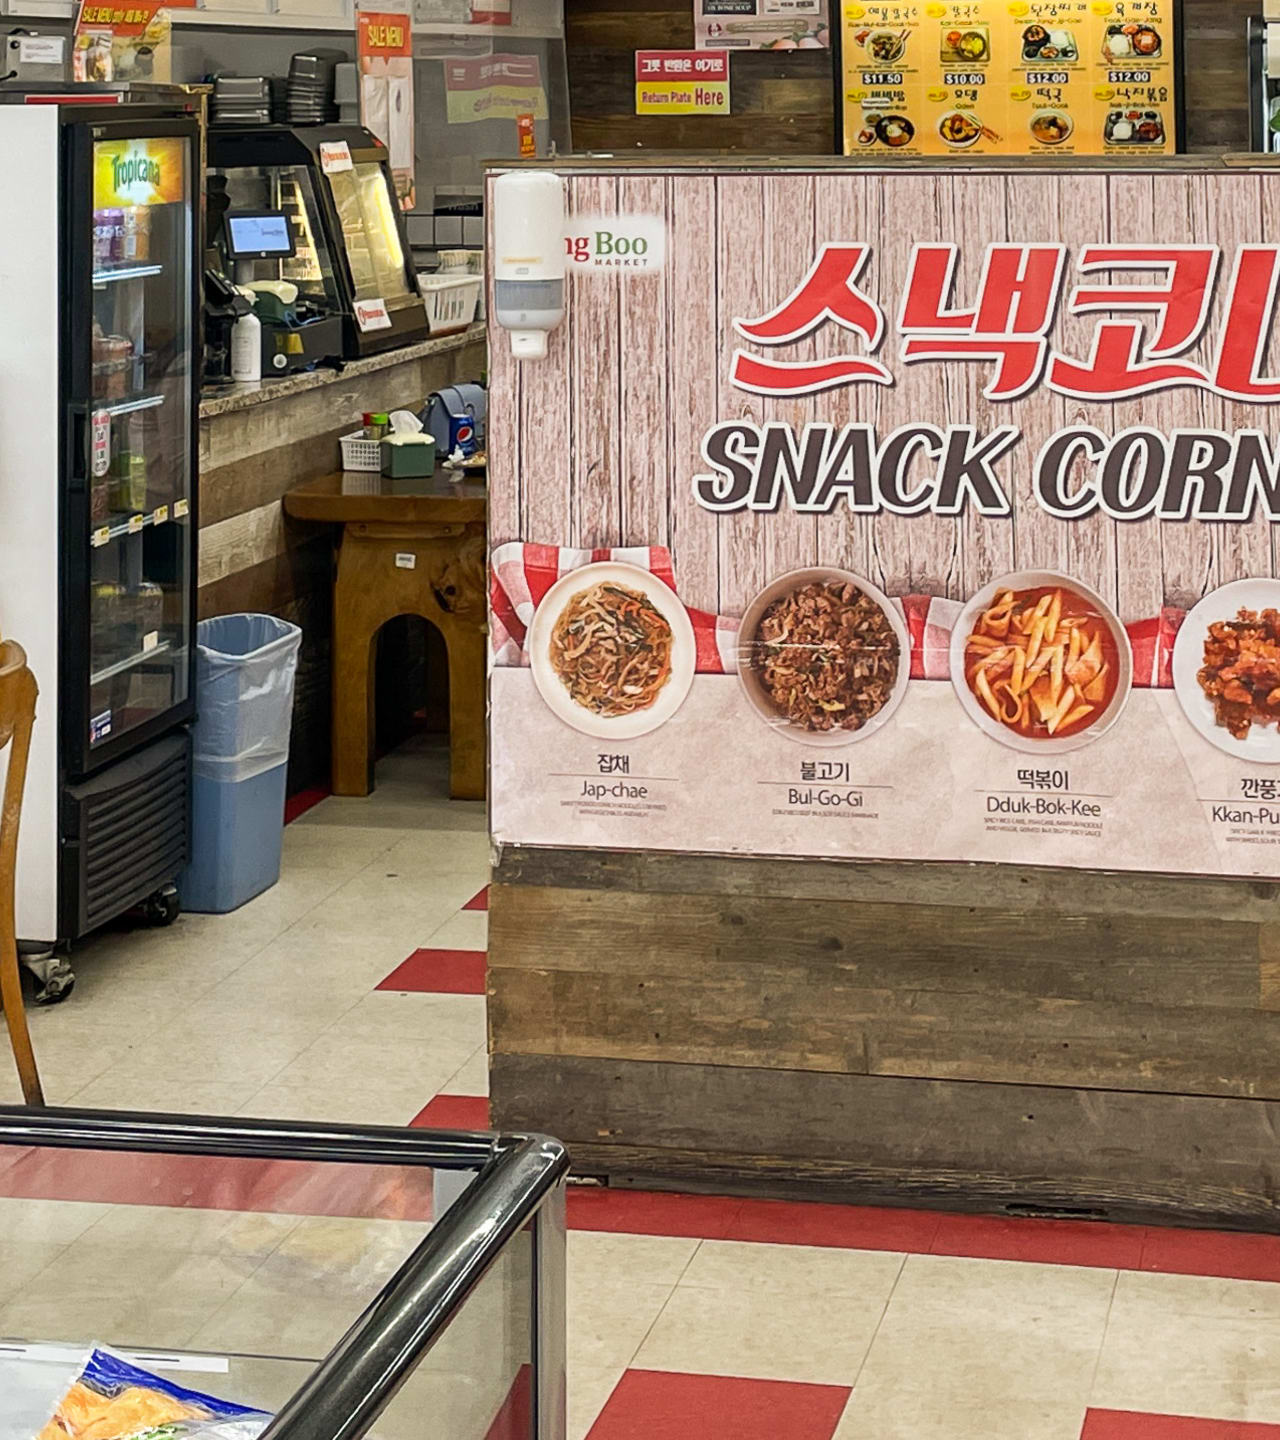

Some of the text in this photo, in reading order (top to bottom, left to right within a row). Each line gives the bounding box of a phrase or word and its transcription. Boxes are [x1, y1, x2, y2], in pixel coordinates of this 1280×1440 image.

[368, 25, 403, 48] SALE MENU
[864, 74, 901, 83] $11.50
[946, 74, 984, 84] $10.00
[1029, 74, 1067, 83] $12.00
[1111, 73, 1149, 82] $12.00
[642, 87, 724, 106] Return Plate Here
[111, 150, 160, 192] Tropicana
[595, 231, 648, 255] Boo
[692, 420, 1023, 516] SNACK
[597, 753, 630, 773] 잡채
[800, 762, 850, 782] 불고기
[1017, 769, 1069, 791] 떡볶이
[581, 781, 648, 800] Jap-chae
[789, 788, 863, 807] Bul-Go-Gi
[987, 796, 1101, 817] Dduk-Bok-Kee
